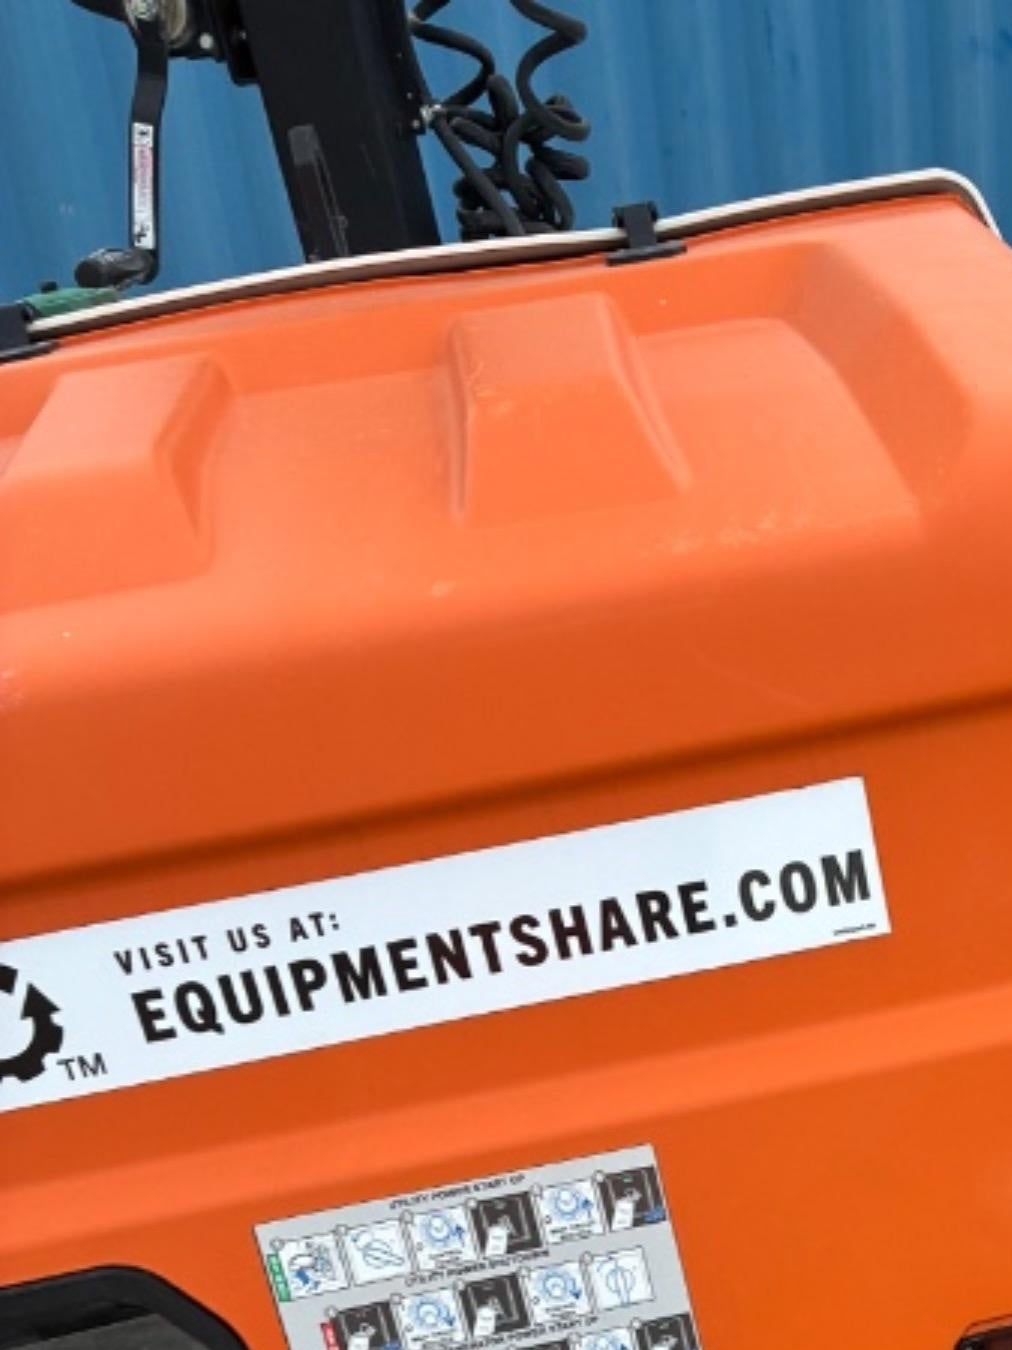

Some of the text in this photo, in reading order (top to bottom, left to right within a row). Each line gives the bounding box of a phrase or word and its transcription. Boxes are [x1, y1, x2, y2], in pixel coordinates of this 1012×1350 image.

[114, 908, 341, 976] VISIT US AT:
[131, 848, 872, 1044] EQUIPMENTSHARE.COM
[57, 1053, 108, 1082] TM
